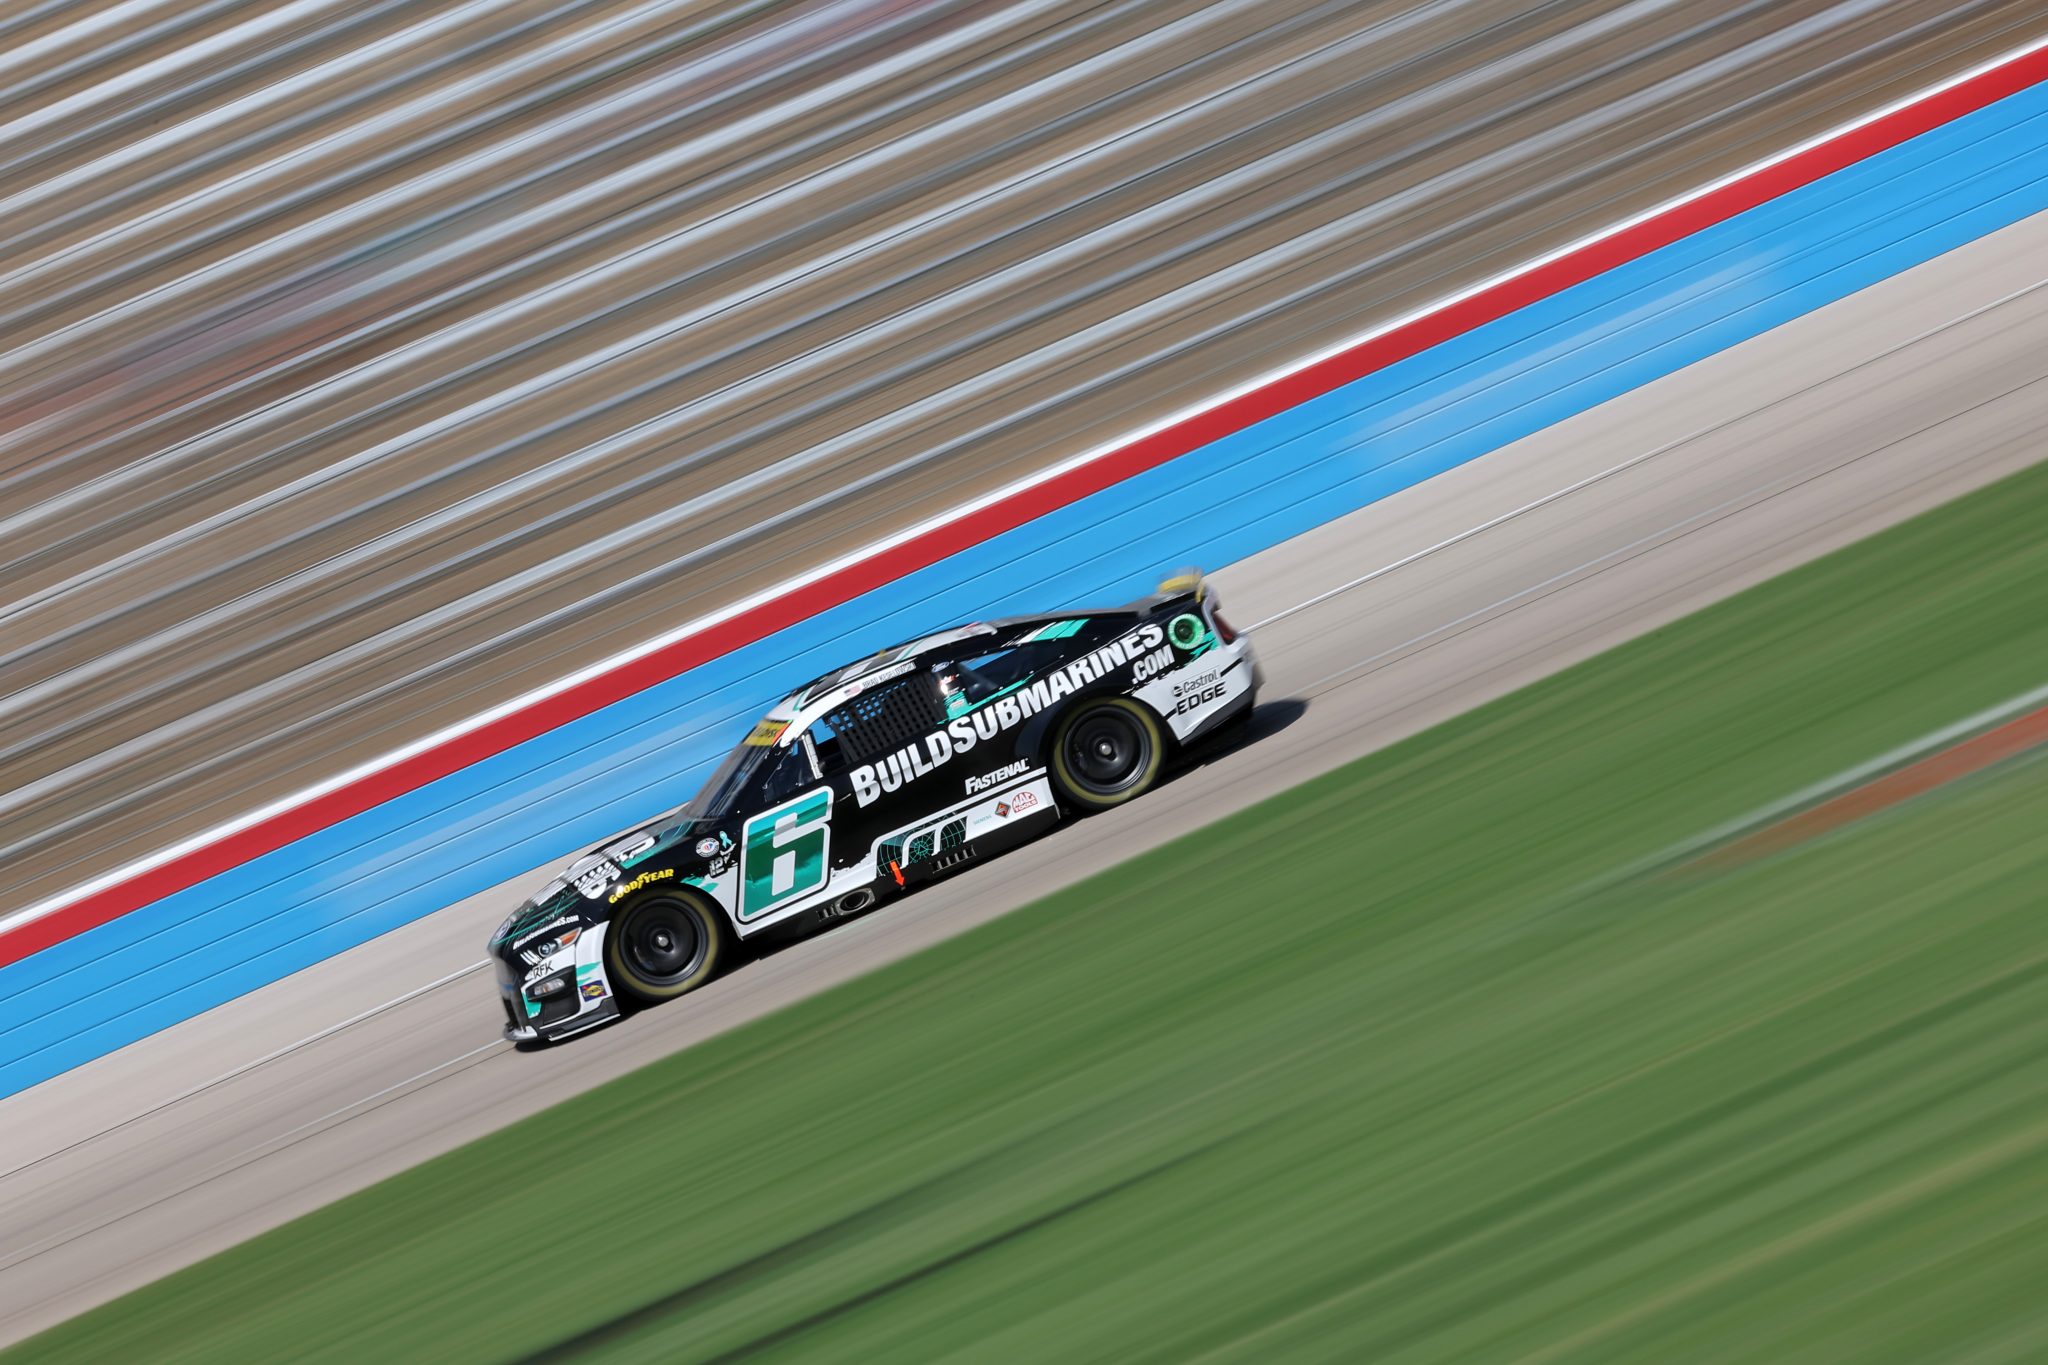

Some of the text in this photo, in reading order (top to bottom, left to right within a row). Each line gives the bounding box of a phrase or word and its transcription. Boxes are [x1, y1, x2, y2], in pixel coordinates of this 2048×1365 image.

[1175, 681, 1228, 716] EDGE
[1183, 669, 1218, 694] Castrol
[850, 623, 1164, 808] BUILDSUBMARINES
[965, 758, 1030, 796] FASTENAL
[1012, 791, 1038, 809] MAC
[740, 787, 833, 923] 6
[608, 868, 675, 904] GOODYEAR
[532, 961, 555, 980] RFK
